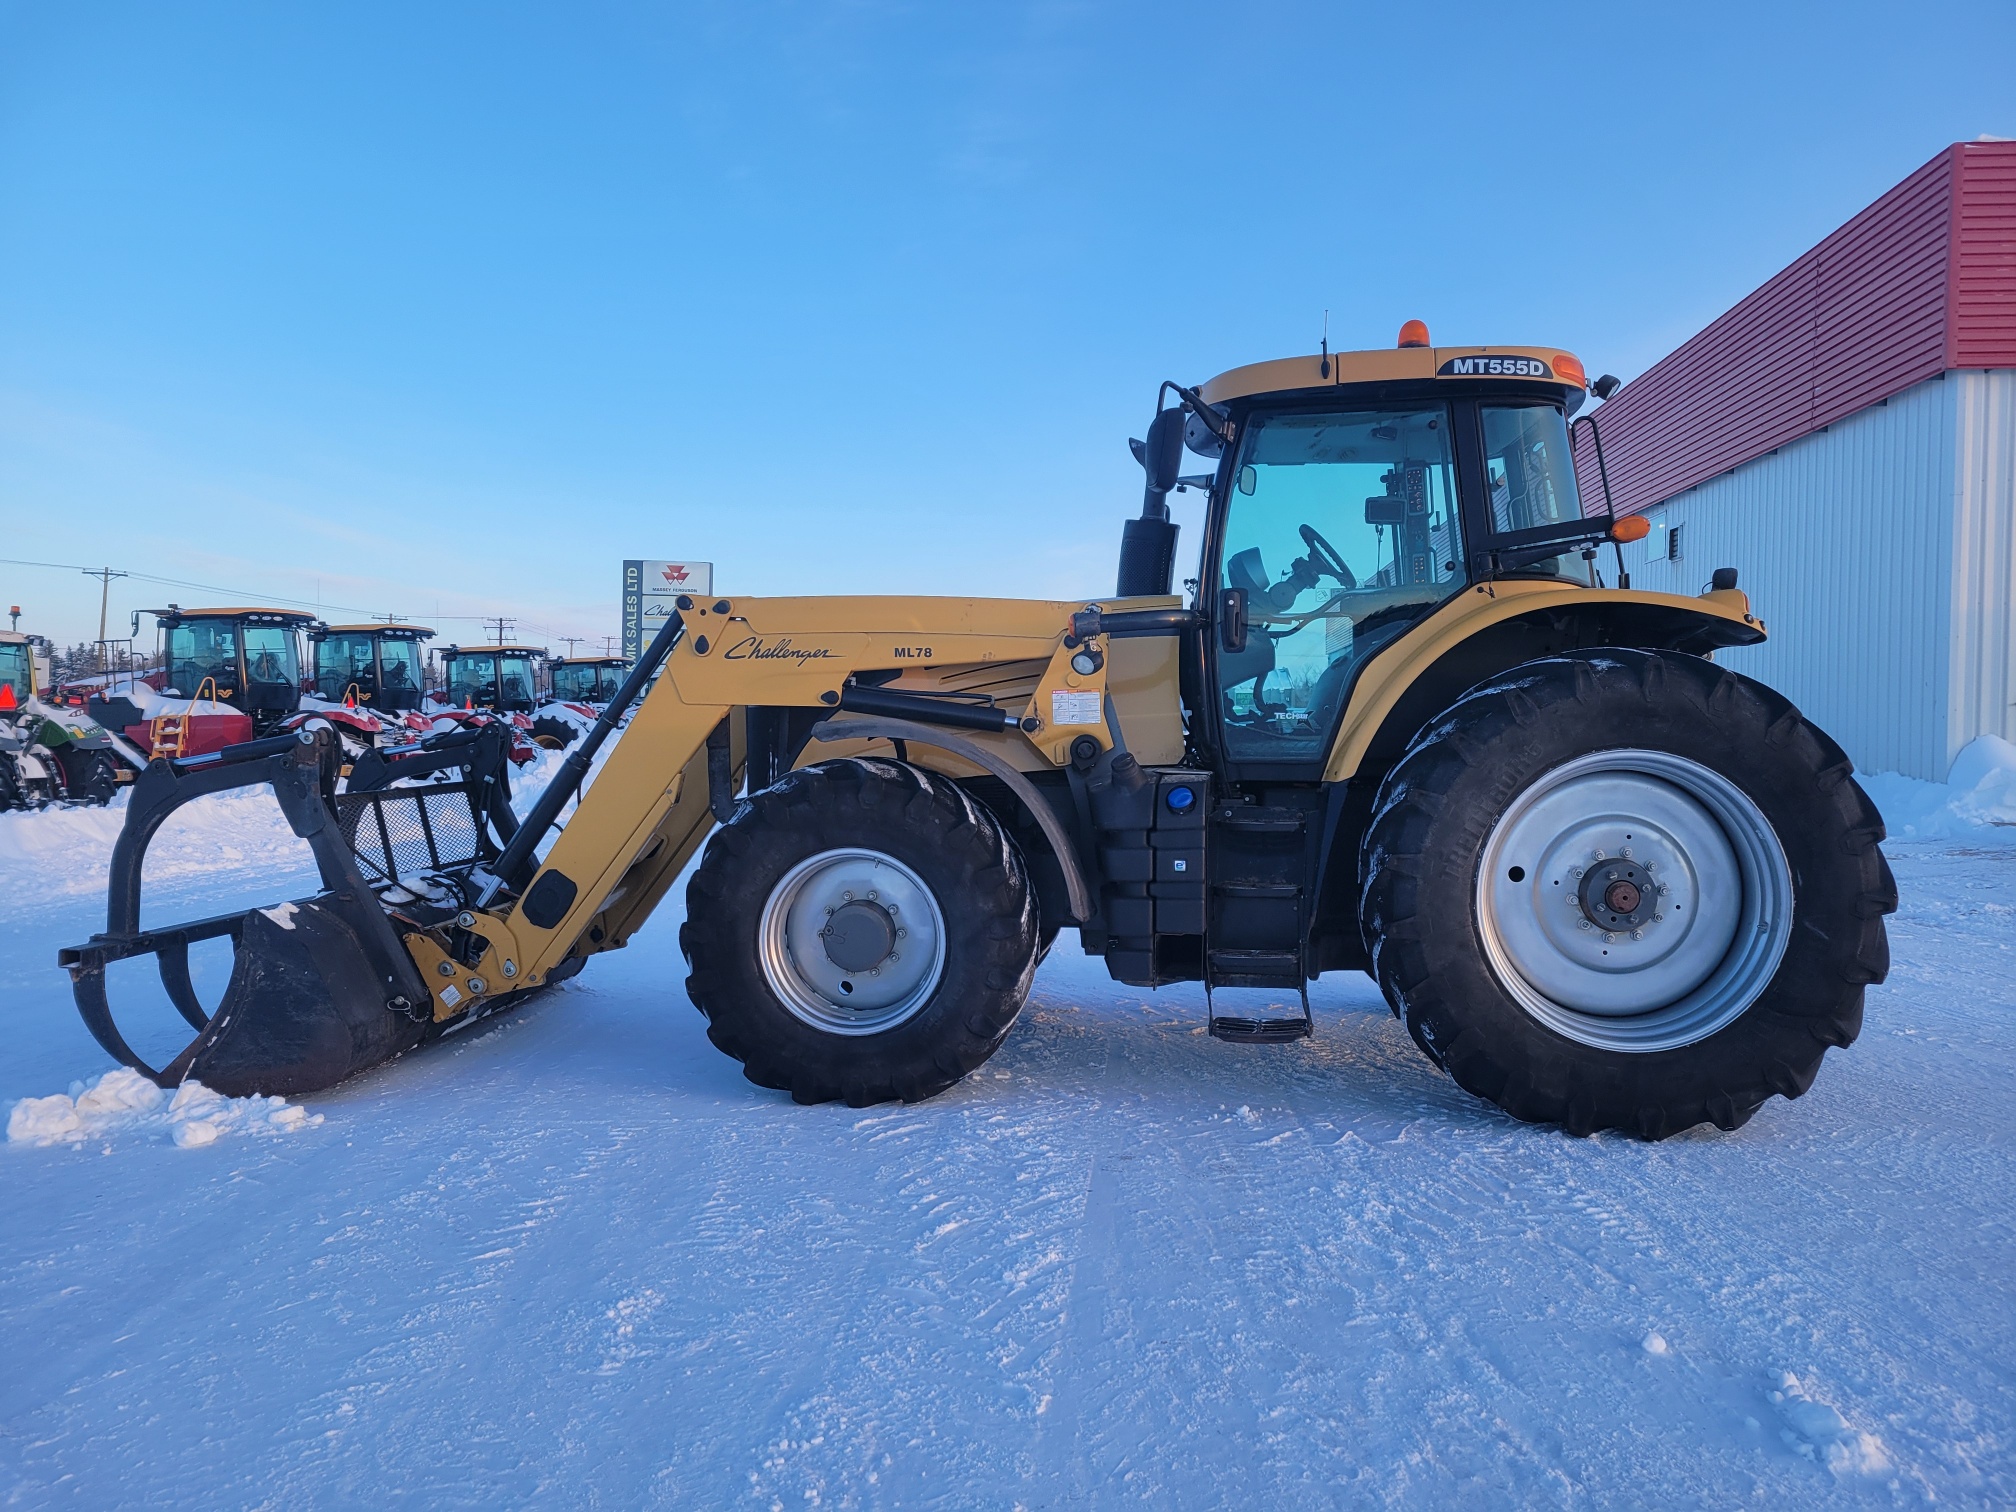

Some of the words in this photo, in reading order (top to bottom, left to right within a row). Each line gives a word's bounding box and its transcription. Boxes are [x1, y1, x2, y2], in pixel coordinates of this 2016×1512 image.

[1453, 358, 1544, 376] MT555D
[627, 567, 638, 592] LTD
[626, 594, 637, 638] SALES
[724, 636, 847, 668] Challenger
[894, 647, 933, 658] ML78
